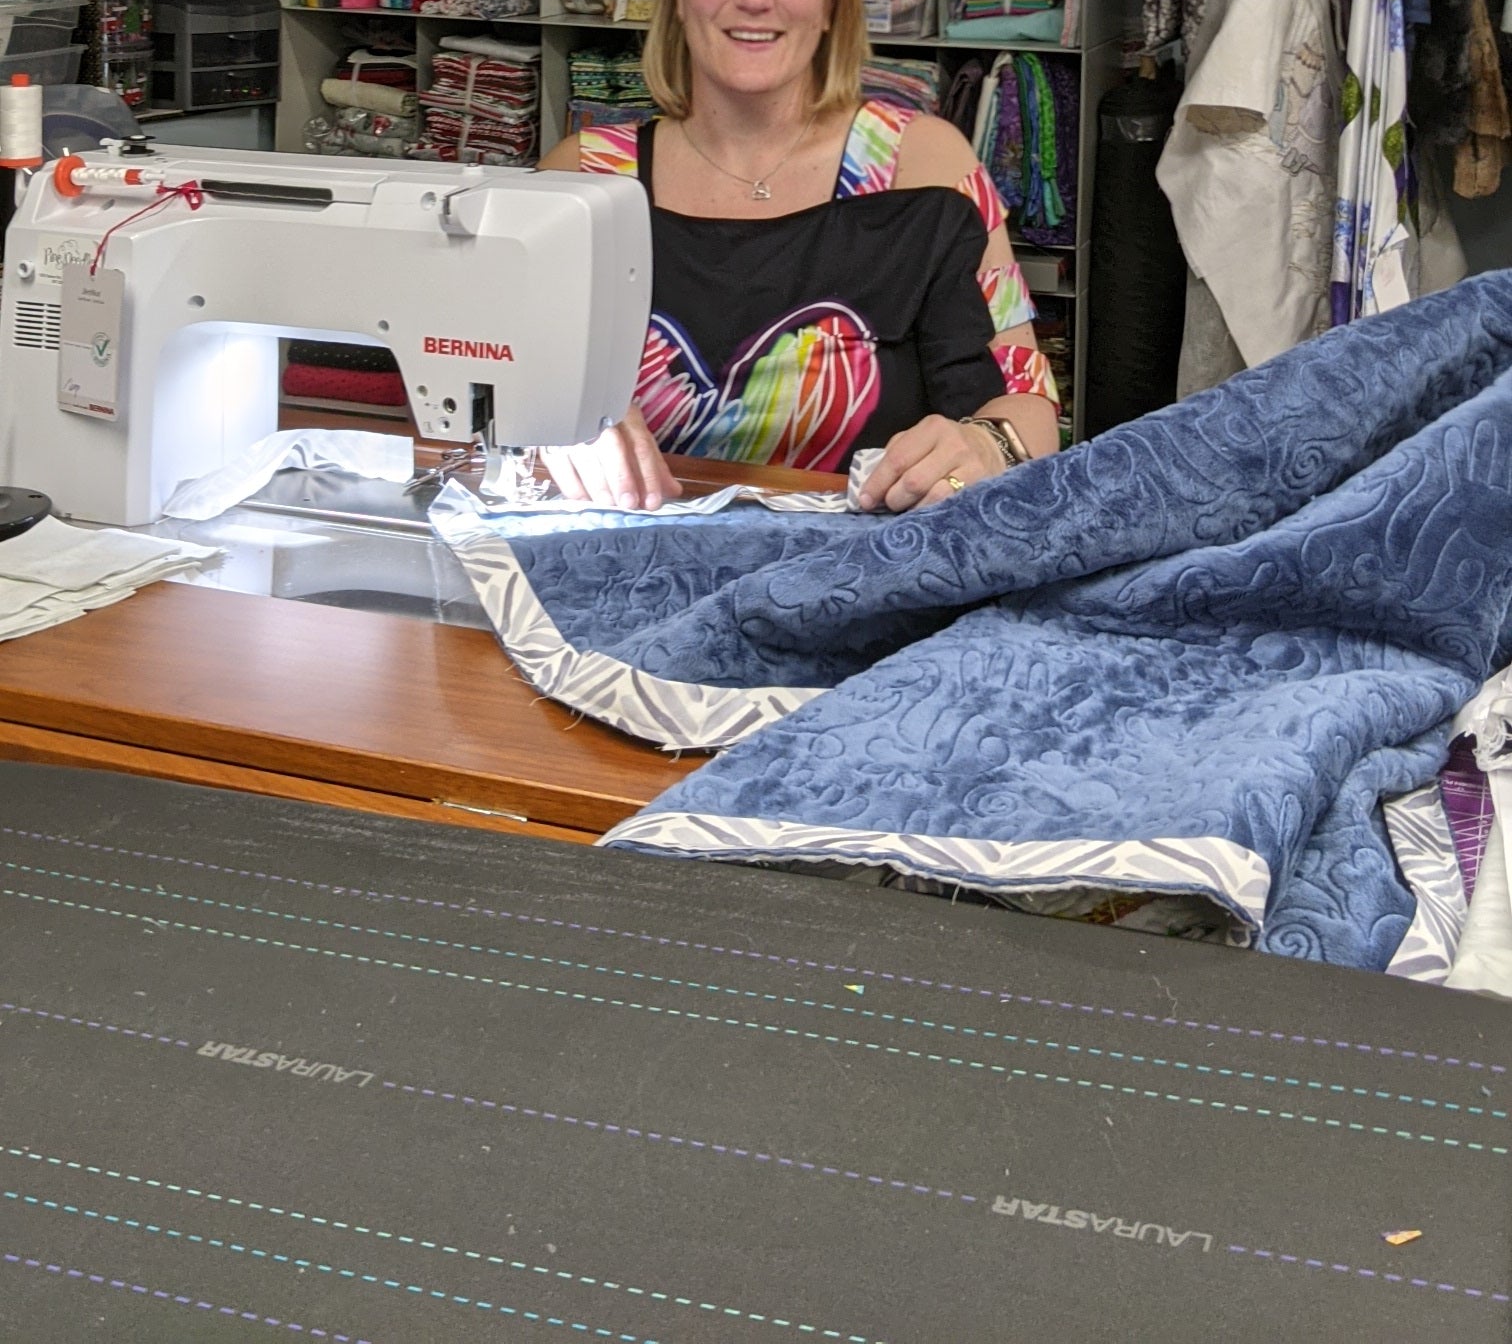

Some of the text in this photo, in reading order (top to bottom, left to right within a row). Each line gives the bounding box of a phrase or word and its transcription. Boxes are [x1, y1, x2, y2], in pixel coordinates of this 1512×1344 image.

[424, 336, 514, 361] BERNINA
[196, 1040, 375, 1088] LAURASTAR
[991, 1195, 1213, 1253] LAURASTAR
